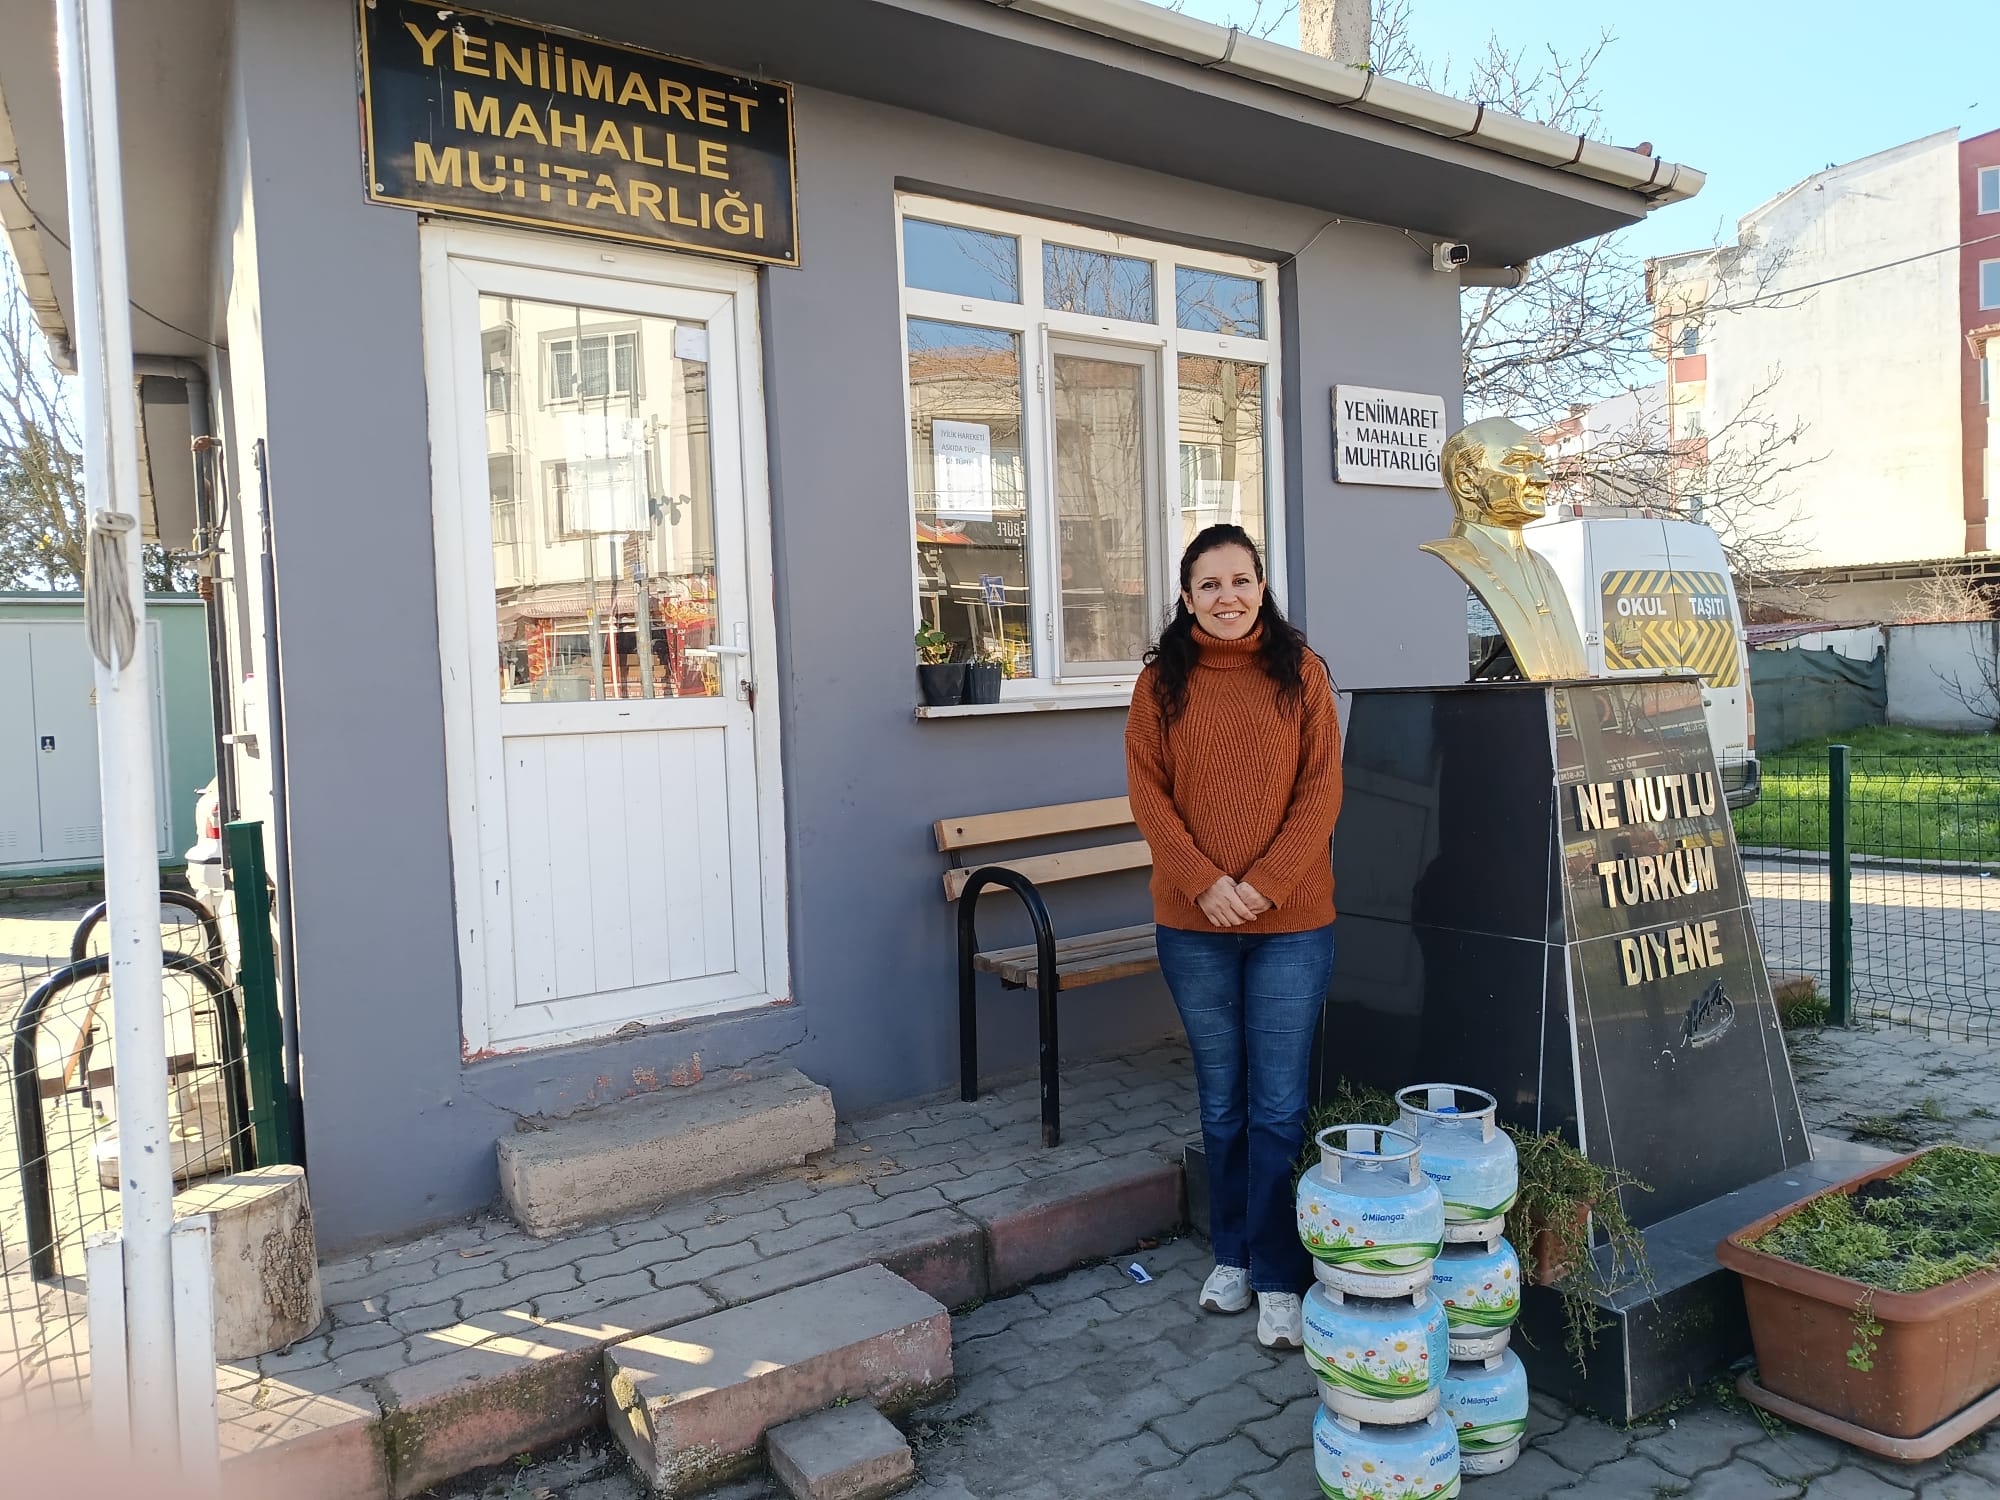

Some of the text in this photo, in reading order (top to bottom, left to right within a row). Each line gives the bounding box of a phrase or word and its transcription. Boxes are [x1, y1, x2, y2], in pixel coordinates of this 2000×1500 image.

[404, 22, 758, 132] YENİİMARET
[453, 90, 730, 180] MAHALLE
[414, 141, 764, 239] MUHTARLIĞI
[1344, 398, 1439, 429] YENİİMARET
[1357, 427, 1428, 448] MAHALLE
[1616, 597, 1726, 619] OKUL TAŞITI
[1576, 772, 1716, 831] NE MUTLU
